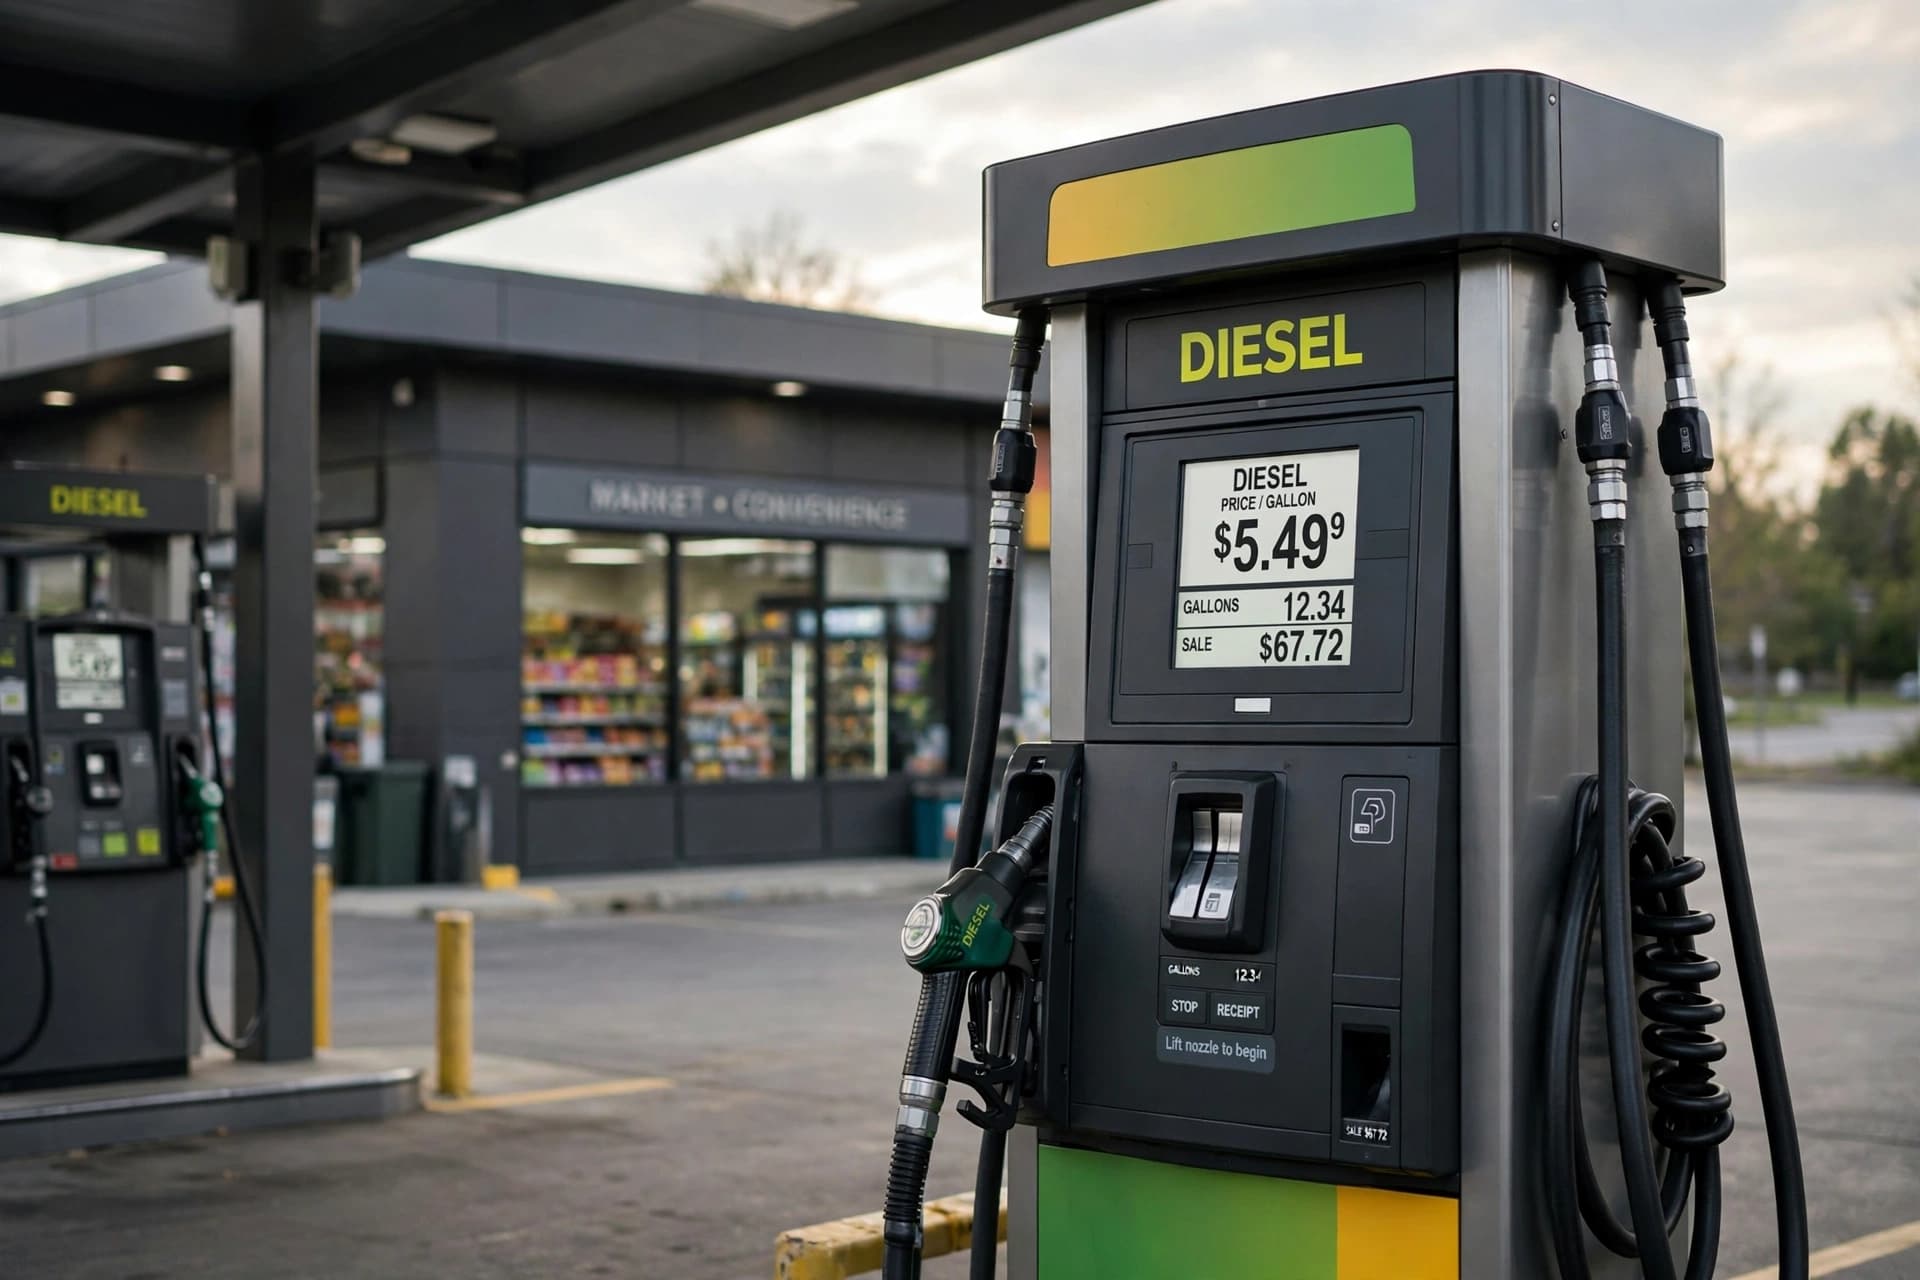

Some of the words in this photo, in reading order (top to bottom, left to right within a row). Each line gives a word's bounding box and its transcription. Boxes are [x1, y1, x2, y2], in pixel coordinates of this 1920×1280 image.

[1180, 313, 1363, 384] DIESEL
[1233, 463, 1308, 492] DIESEL
[50, 485, 147, 518] DIESEL
[590, 480, 705, 517] MARKET
[732, 488, 908, 529] CONVENIENCE
[1221, 496, 1256, 512] PRICE
[1266, 491, 1316, 509] GALLON
[1183, 597, 1240, 614] GALLONS
[1283, 589, 1345, 622] 12.34
[1182, 636, 1212, 652] SALE
[1259, 628, 1343, 664] $67.72
[962, 903, 990, 948] DIESEL
[1171, 999, 1198, 1013] STOP
[1217, 1003, 1260, 1019] RECEIPT
[1165, 1036, 1183, 1051] Lift
[1185, 1040, 1219, 1054] nozzle
[1222, 1042, 1233, 1056] to
[1235, 1042, 1267, 1062] begin
